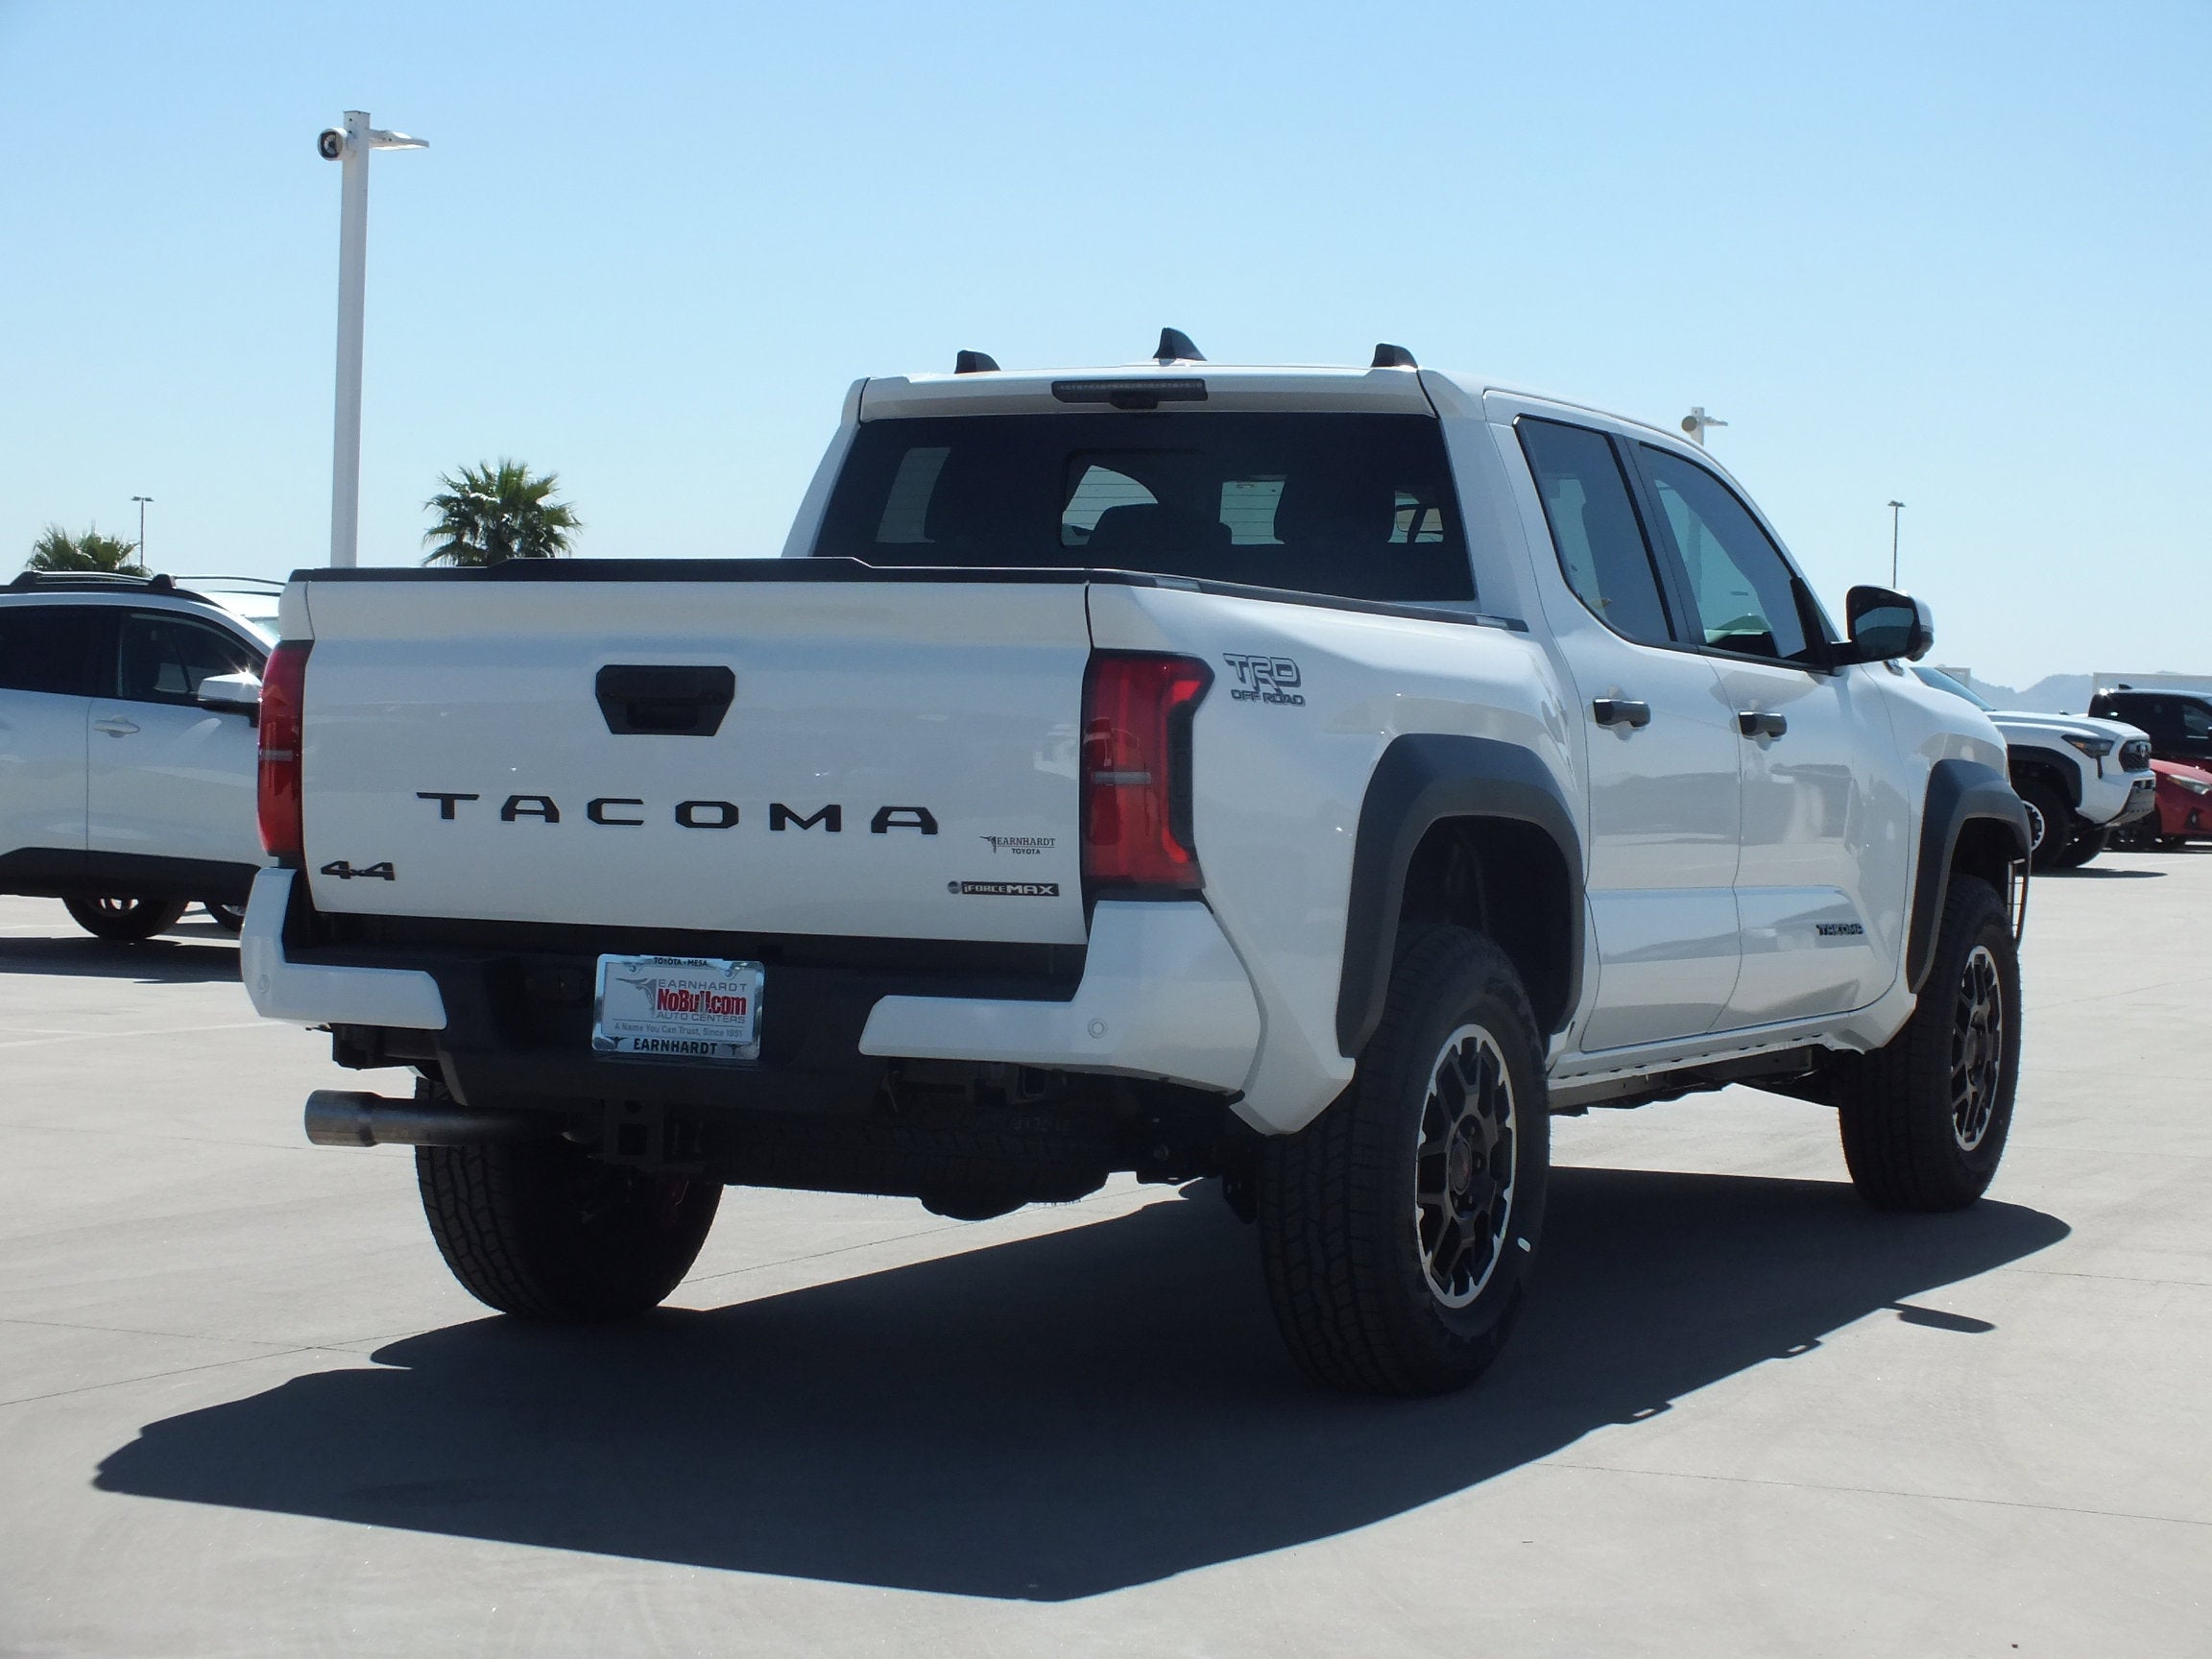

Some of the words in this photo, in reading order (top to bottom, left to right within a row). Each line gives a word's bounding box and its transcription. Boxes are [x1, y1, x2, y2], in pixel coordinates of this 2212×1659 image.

[1222, 653, 1301, 692] TRD
[1231, 689, 1262, 702] OFF
[1262, 692, 1306, 707] ROAD
[416, 792, 938, 834] TACOMA
[997, 837, 1056, 846] EARNHARDT
[654, 957, 682, 966] TOYOTA
[658, 978, 747, 992] EARNHARDT
[656, 1011, 688, 1021] AUTO
[691, 1013, 746, 1024] CENTERS
[622, 1023, 643, 1032] Name
[646, 1024, 660, 1033] You
[661, 1025, 677, 1034] Can
[703, 1027, 725, 1037] Since
[633, 1038, 718, 1054] EARNHARDT
